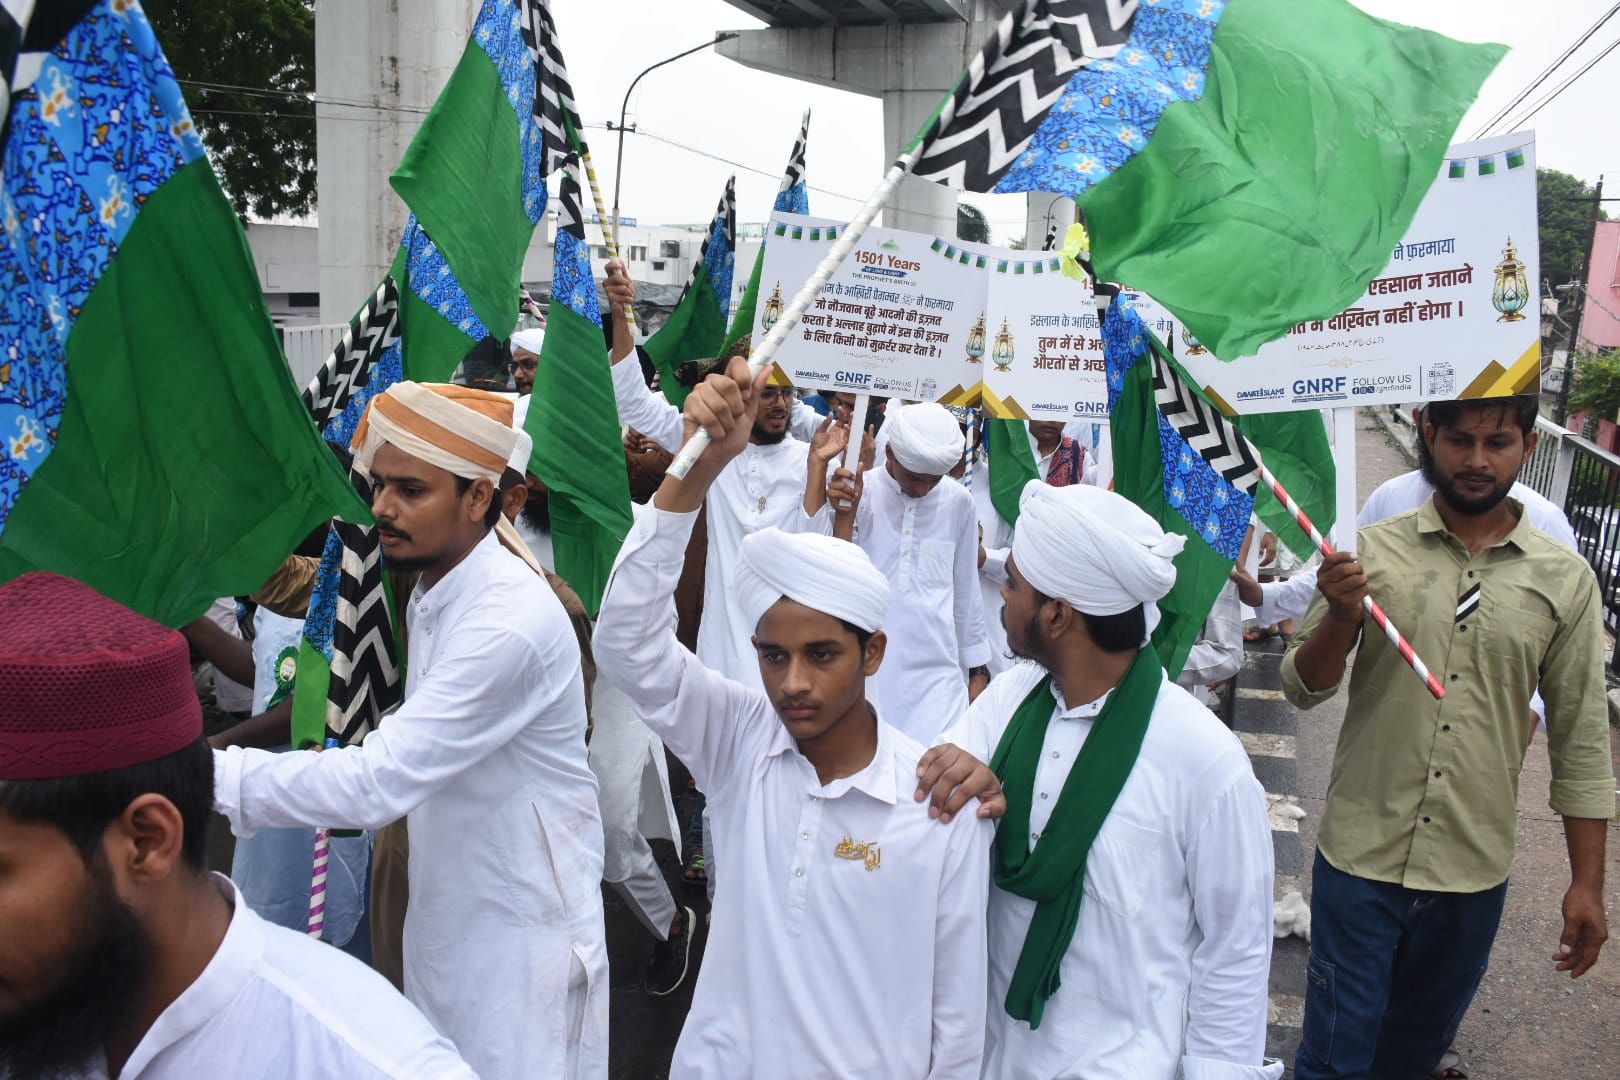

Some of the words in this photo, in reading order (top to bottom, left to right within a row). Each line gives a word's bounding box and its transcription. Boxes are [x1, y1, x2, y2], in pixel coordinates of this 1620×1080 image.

[855, 250, 884, 266] 1501
[887, 255, 921, 272] Years
[1368, 274, 1423, 296] एहसान
[1425, 263, 1474, 288] जताने
[836, 283, 843, 295] के
[917, 294, 924, 306] ने
[815, 298, 826, 310] जो
[828, 299, 863, 315] नौजवान
[878, 308, 905, 321] आदमी
[906, 309, 918, 322] की
[1030, 315, 1060, 328] इस्लाम
[1061, 313, 1070, 327] के
[1383, 301, 1417, 324] नहीं
[1417, 299, 1453, 321] होगा
[802, 314, 825, 327] करता
[826, 314, 834, 327] है
[835, 318, 866, 331] अल्लाह
[888, 323, 899, 336] में
[898, 326, 912, 338] इस
[913, 327, 925, 339] की
[803, 328, 812, 341] के
[814, 329, 833, 343] लिए
[833, 331, 856, 346] किसी
[857, 335, 868, 348] को
[898, 343, 913, 354] कर
[913, 342, 928, 356] देता
[929, 345, 936, 357] है
[1038, 337, 1058, 352] तुम
[1060, 334, 1073, 350] में
[1073, 335, 1085, 350] से
[1033, 354, 1067, 371] औरतों
[1068, 355, 1080, 371] से
[835, 371, 872, 384] GNRF
[1292, 376, 1347, 395] GNRF
[1353, 375, 1395, 387] FOLLOW
[1397, 374, 1412, 384] US
